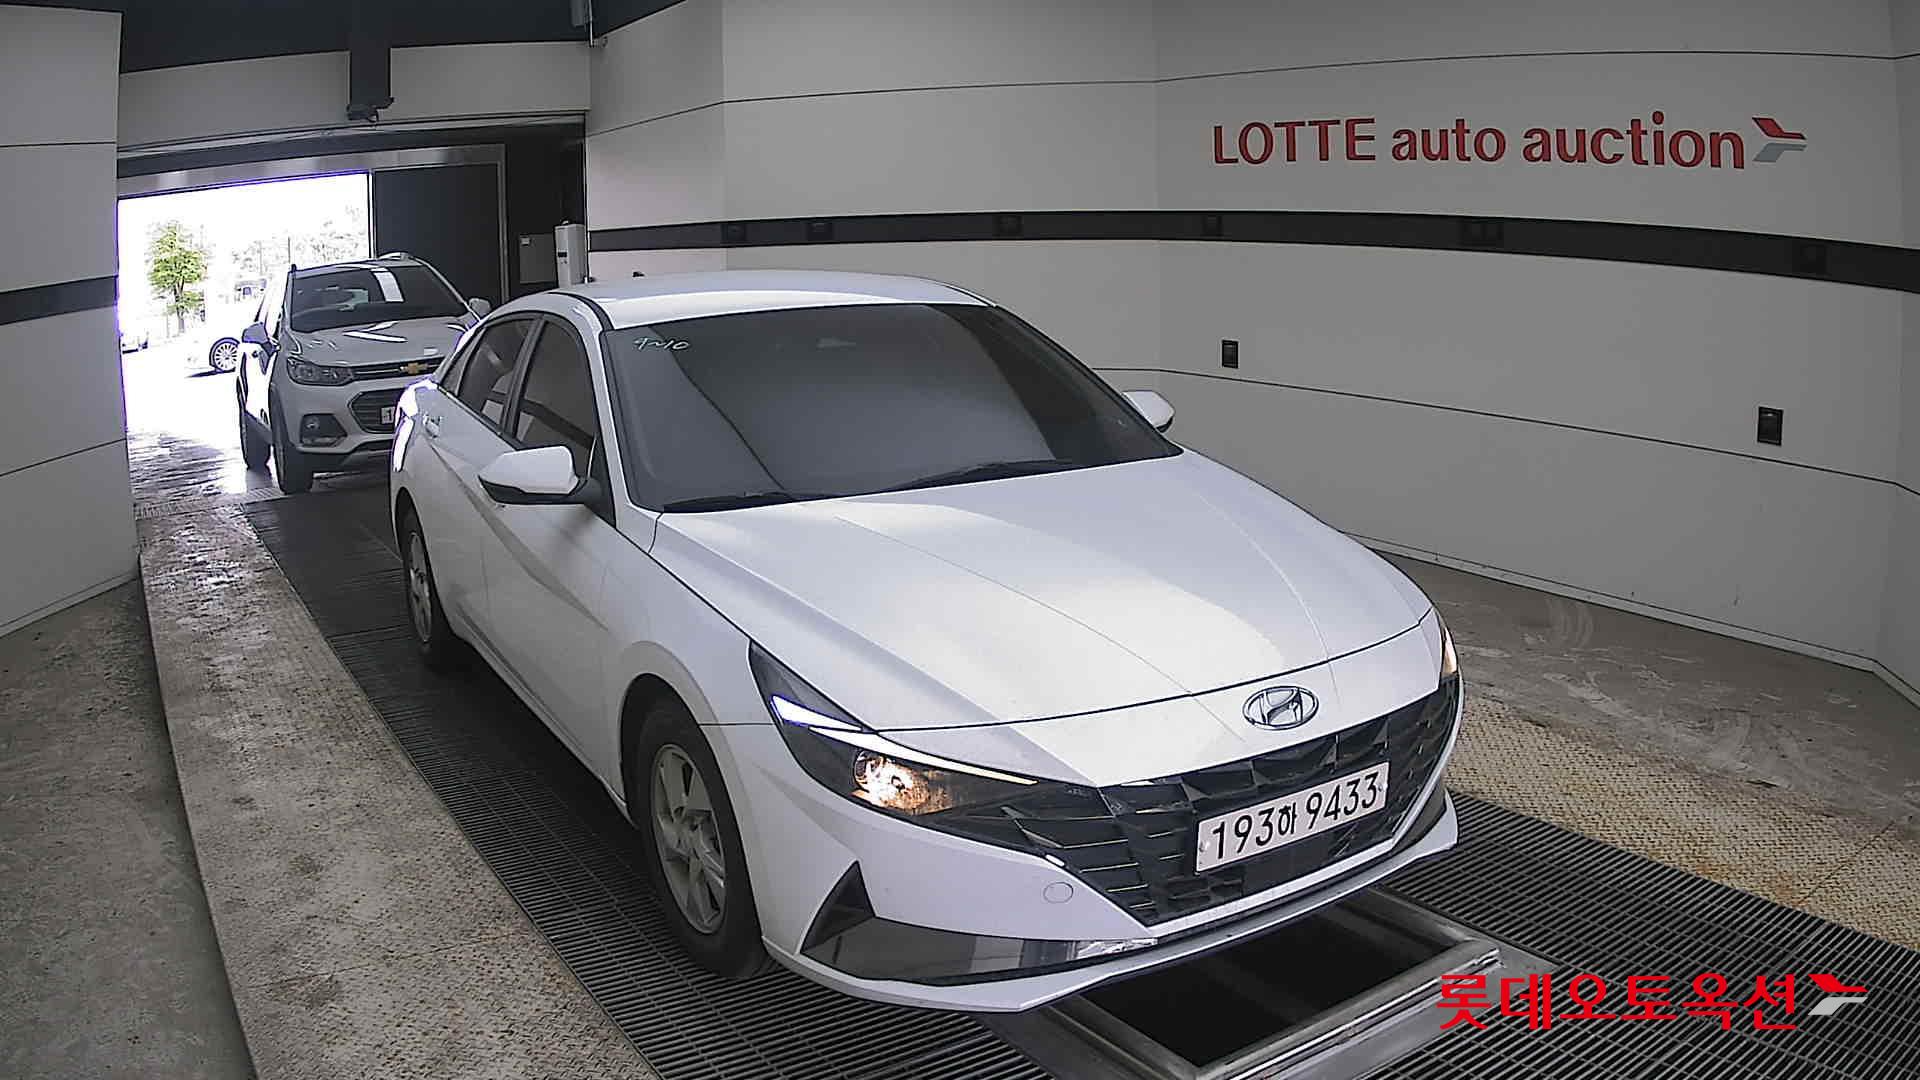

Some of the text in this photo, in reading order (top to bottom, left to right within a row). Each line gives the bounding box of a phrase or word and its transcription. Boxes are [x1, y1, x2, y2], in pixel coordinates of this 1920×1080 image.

[1213, 111, 1745, 169] LOTTE auto auction
[1212, 771, 1380, 860] 193하 9433
